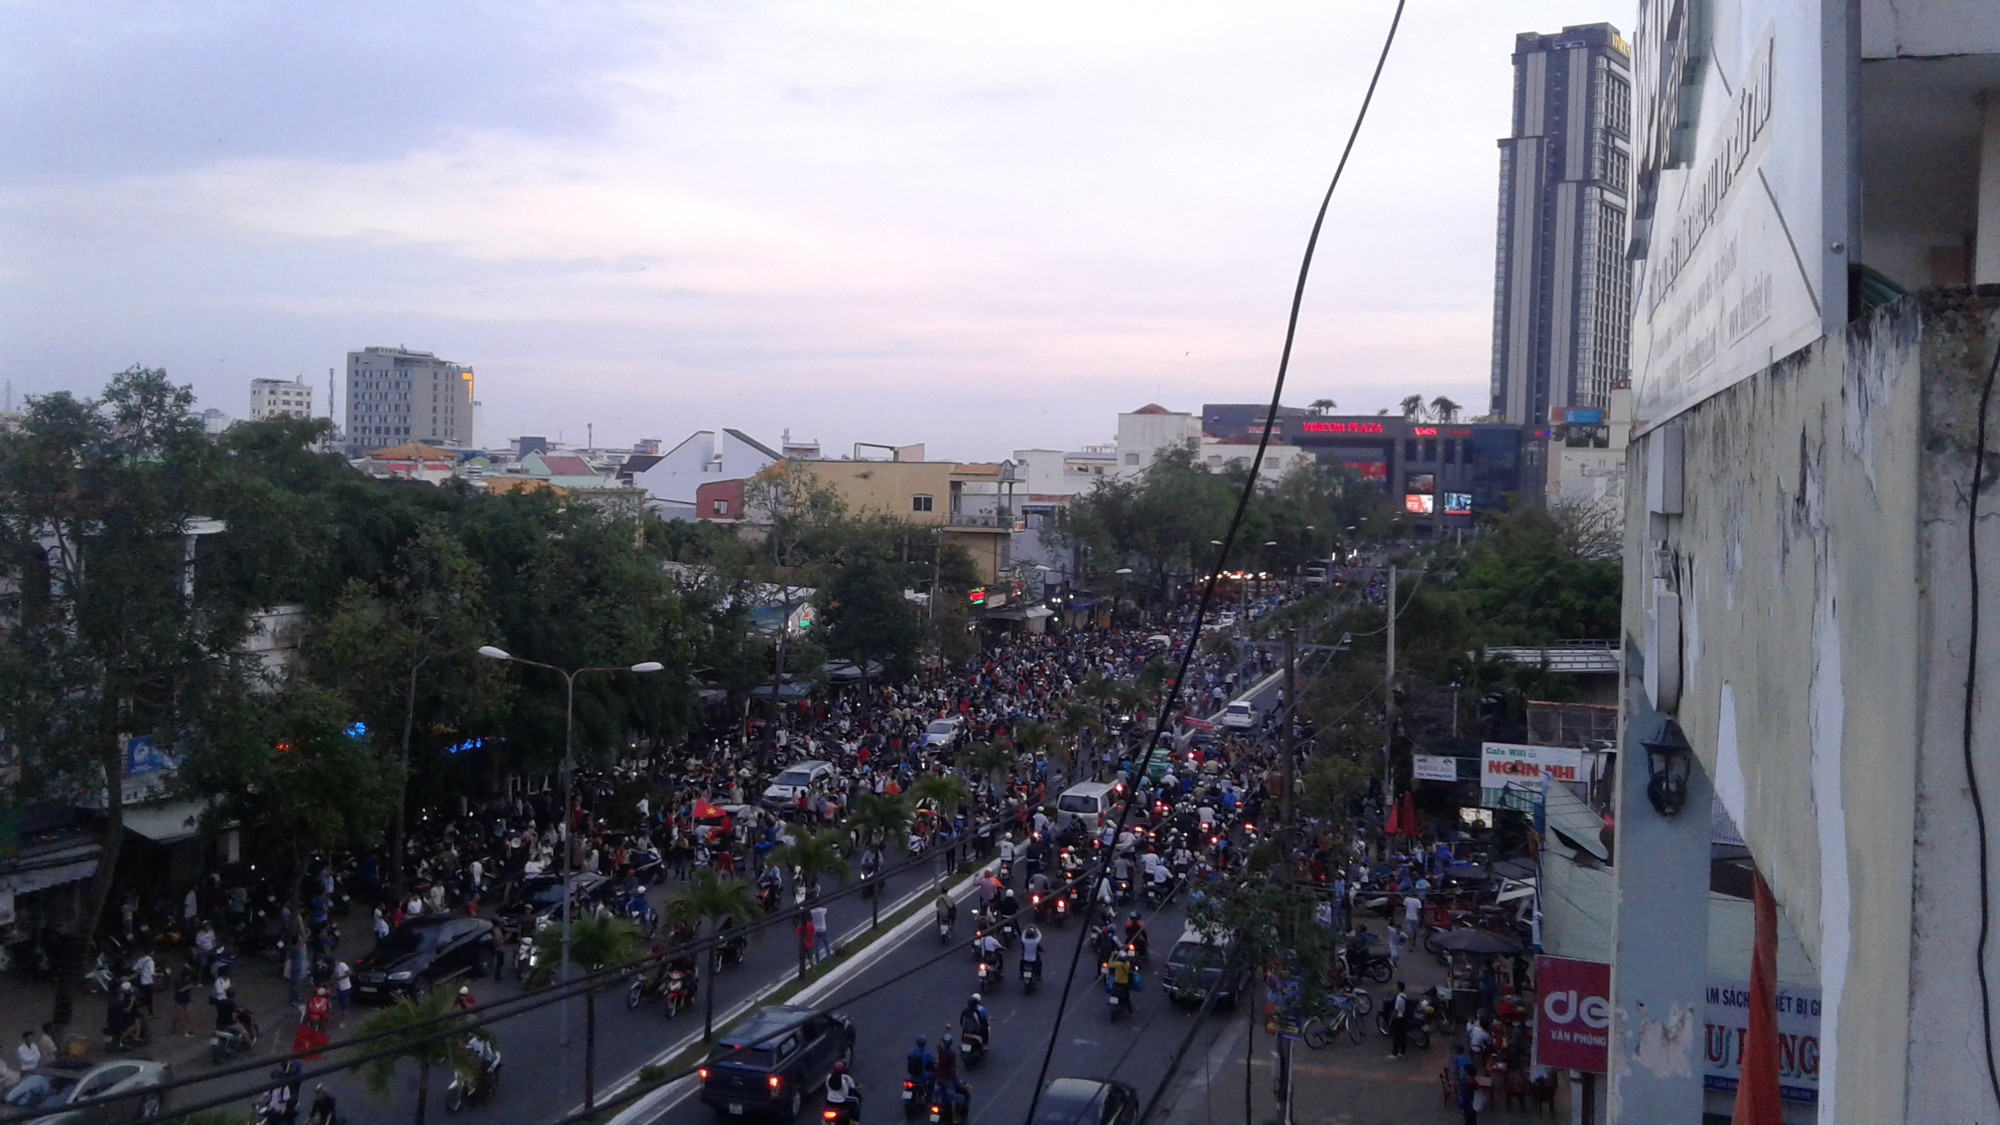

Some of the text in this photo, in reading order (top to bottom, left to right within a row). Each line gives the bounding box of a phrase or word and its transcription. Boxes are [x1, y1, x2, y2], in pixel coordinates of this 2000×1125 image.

[1302, 422, 1385, 433] VINCOM PLAZA
[1486, 746, 1526, 757] Cafe Wifi
